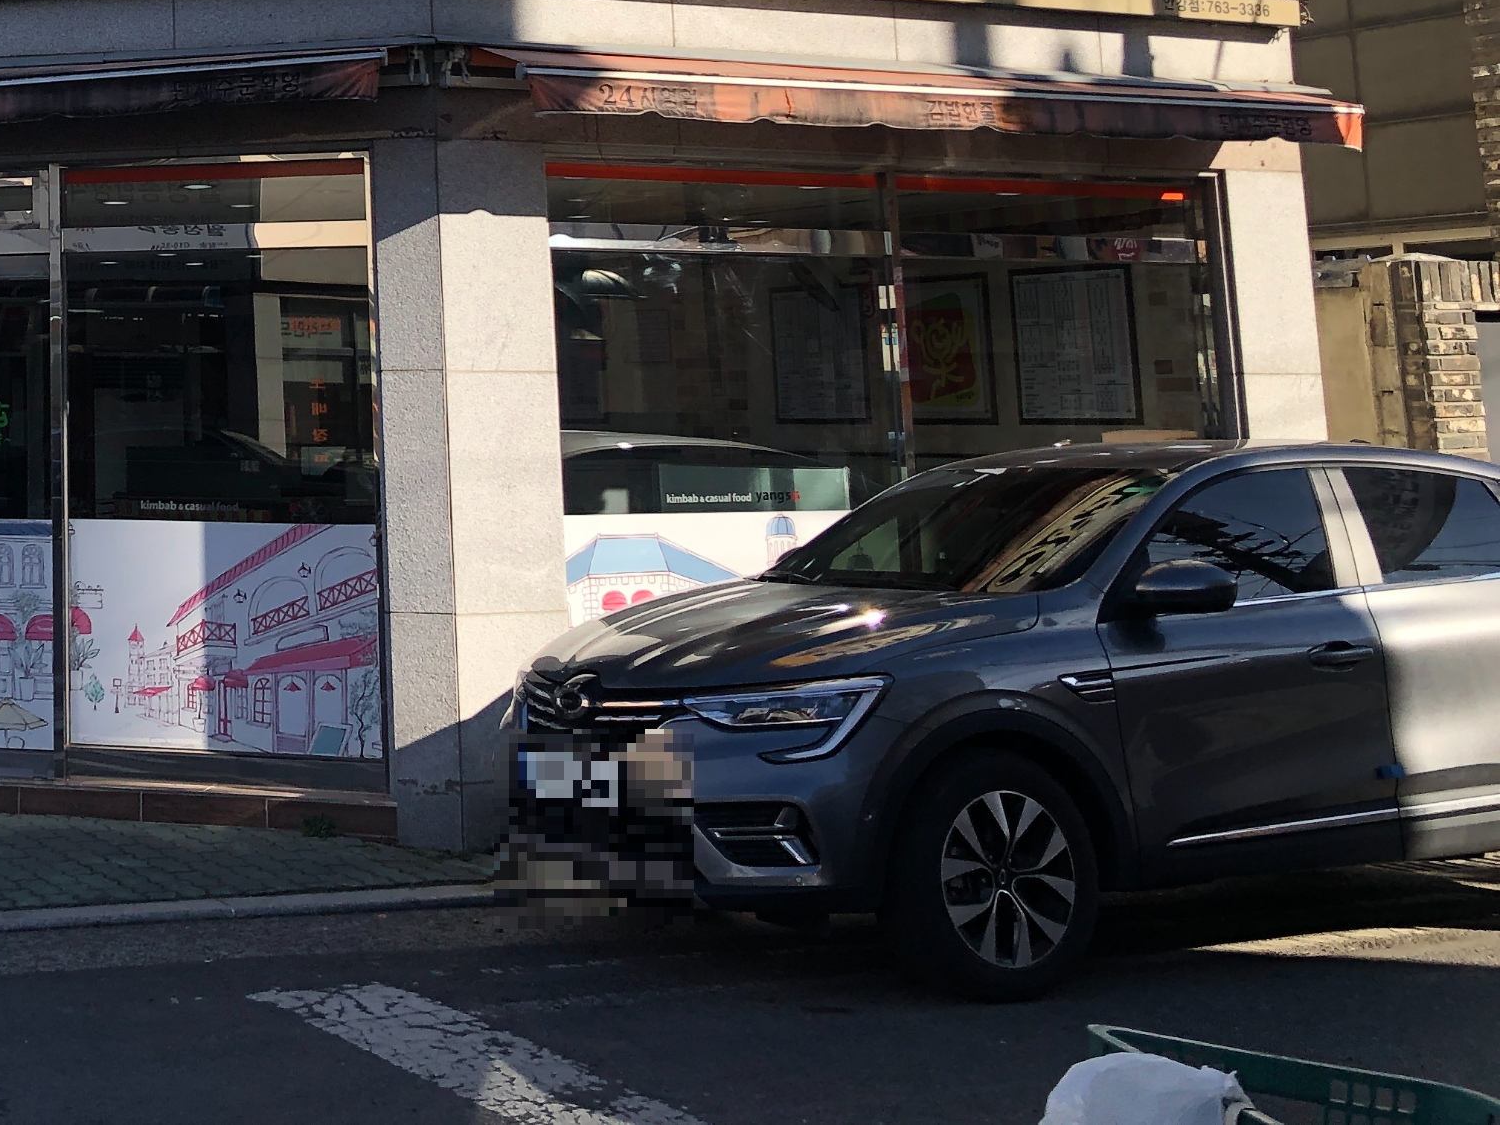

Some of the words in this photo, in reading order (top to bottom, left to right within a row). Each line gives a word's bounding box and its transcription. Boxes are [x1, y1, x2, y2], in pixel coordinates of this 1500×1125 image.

[666, 493, 699, 504] kimbab
[705, 493, 732, 503] casual
[732, 491, 752, 503] food
[140, 500, 177, 511] kimbab
[185, 501, 215, 512] casual
[216, 501, 240, 512] food
